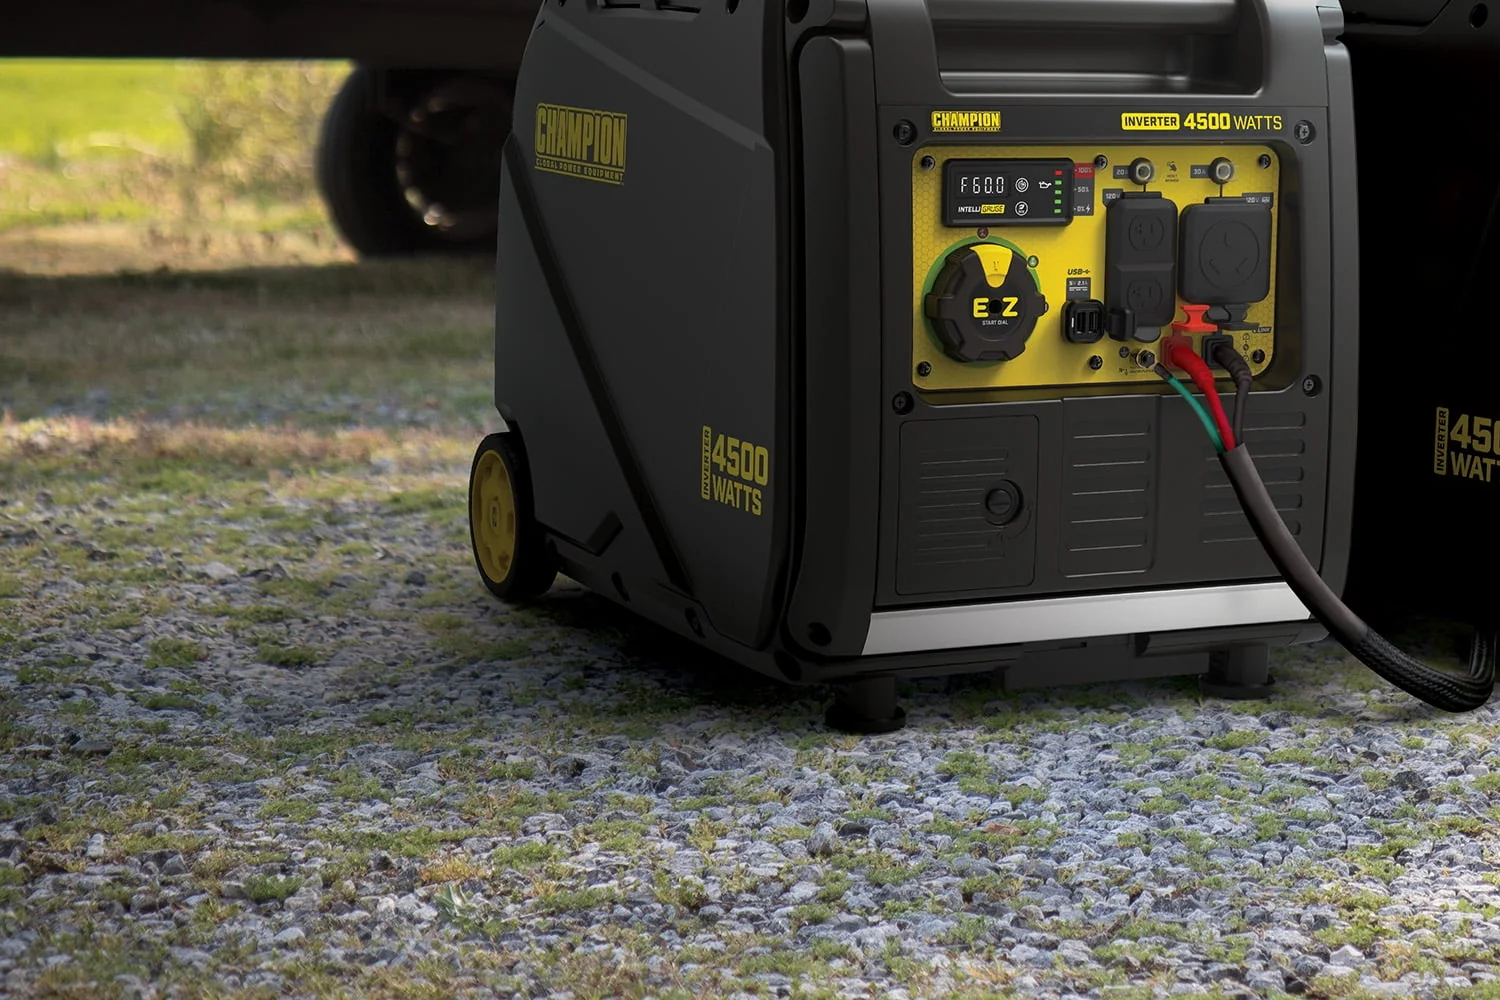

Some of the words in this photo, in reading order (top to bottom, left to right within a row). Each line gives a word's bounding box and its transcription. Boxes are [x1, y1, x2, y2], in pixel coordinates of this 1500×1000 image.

[933, 111, 1000, 128] CHAMPION
[1124, 115, 1178, 127] INVERTER
[1183, 112, 1231, 130] 4500
[1233, 115, 1283, 130] WATTS
[537, 107, 626, 167] CHAMPION
[559, 162, 582, 174] POWER
[583, 166, 624, 181] EQUIPMENT
[1067, 268, 1083, 276] USB
[1436, 409, 1447, 472] INVERTER
[711, 433, 769, 487] 4500
[711, 473, 762, 516] WATTS
